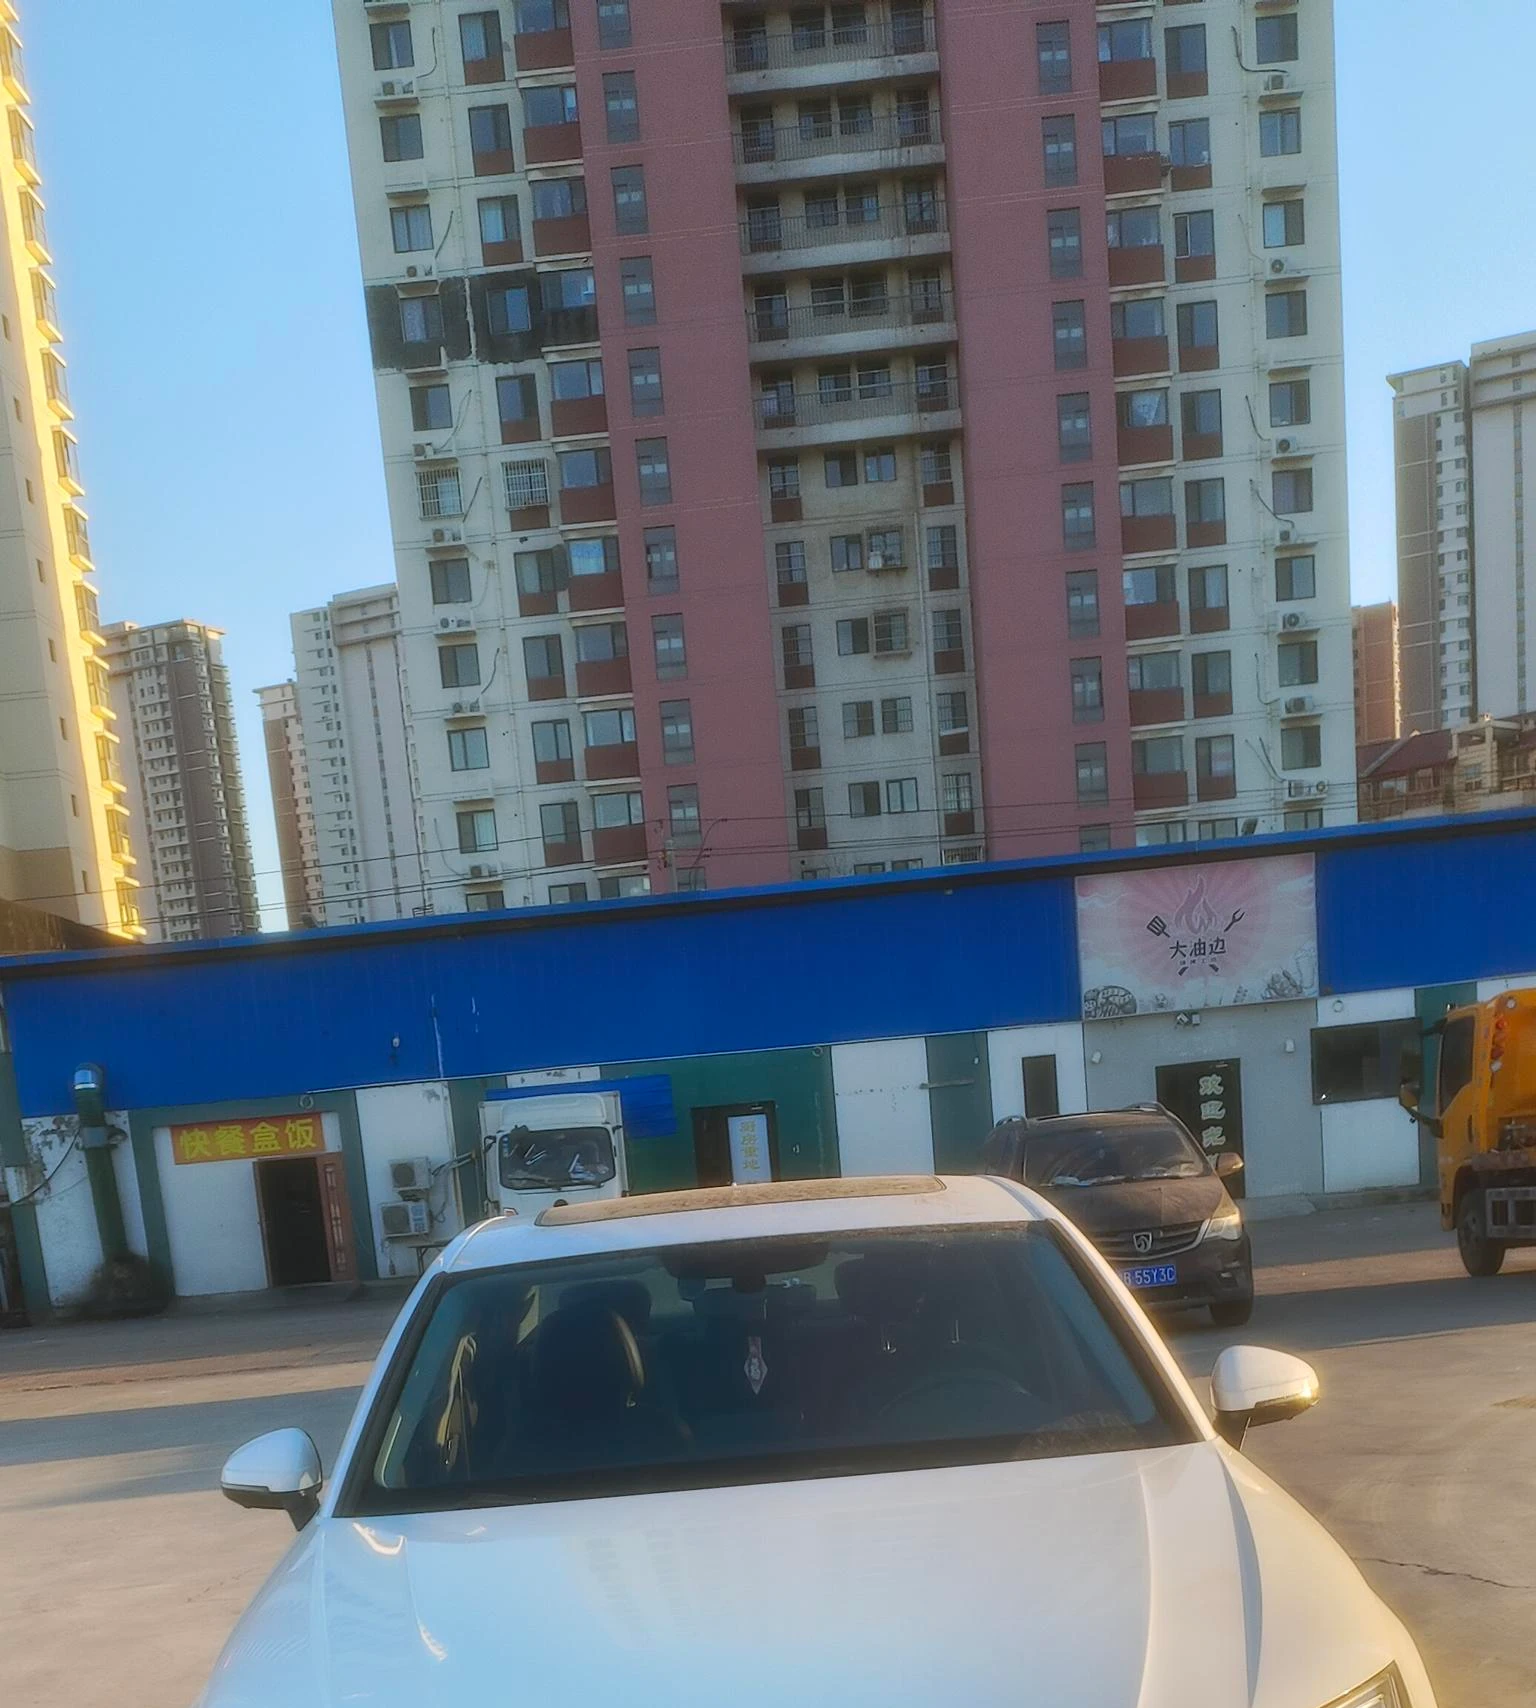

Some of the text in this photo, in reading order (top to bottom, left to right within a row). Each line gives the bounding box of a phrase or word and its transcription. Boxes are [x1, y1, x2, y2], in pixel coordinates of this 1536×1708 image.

[1169, 937, 1226, 959] 大油边
[180, 1118, 316, 1160] 快餐盒饭
